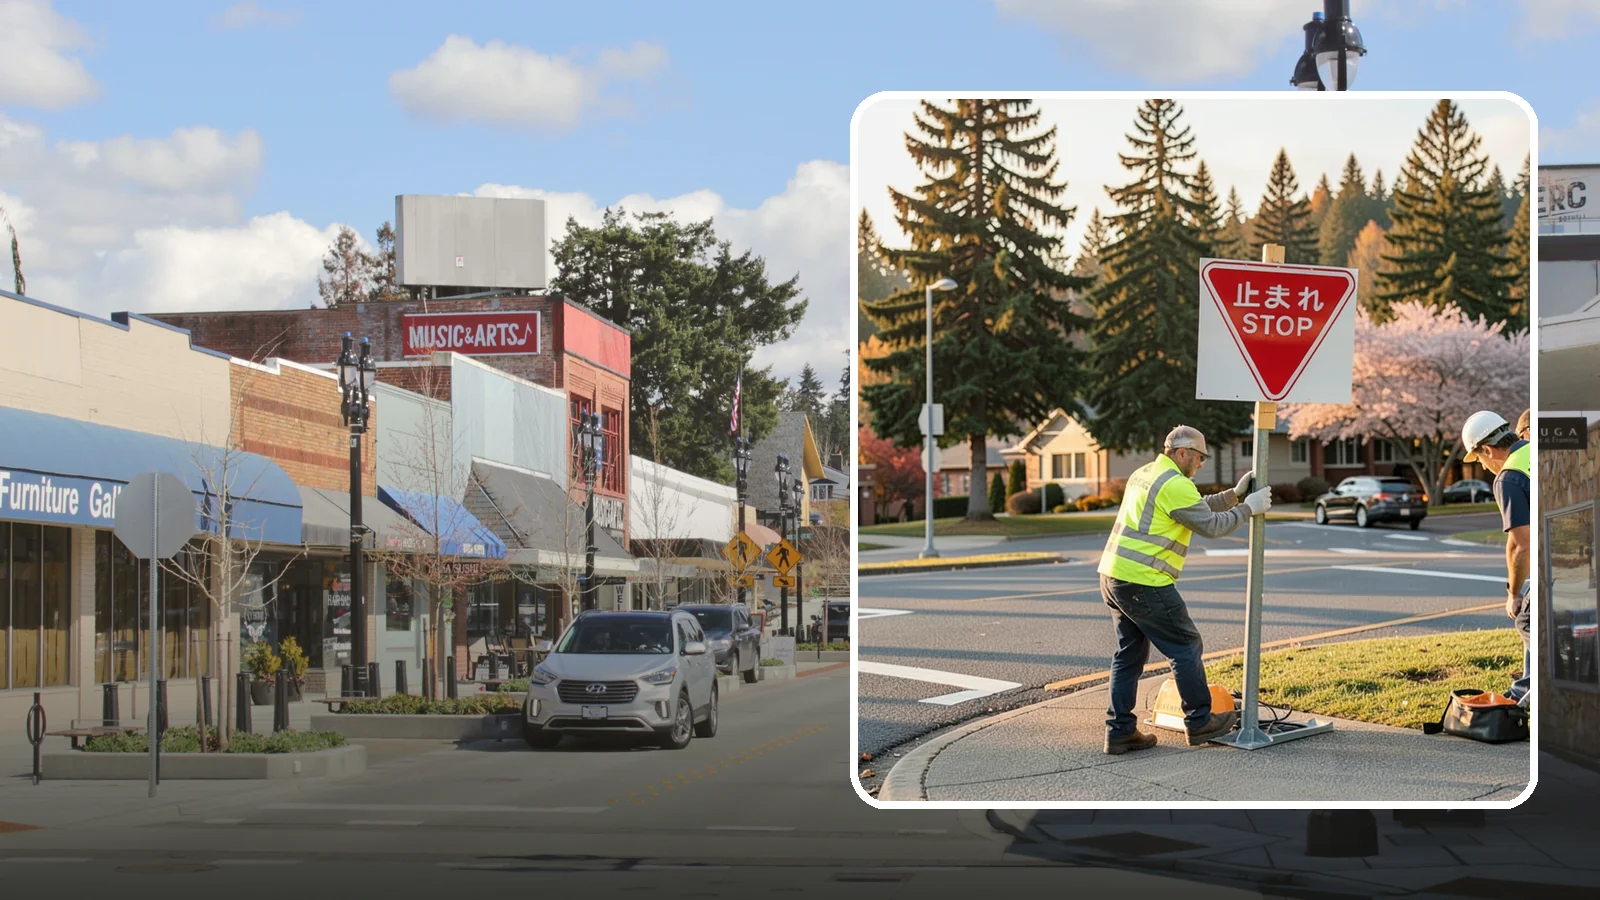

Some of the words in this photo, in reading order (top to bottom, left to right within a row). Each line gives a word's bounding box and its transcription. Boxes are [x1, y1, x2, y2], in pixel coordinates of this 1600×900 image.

[1233, 281, 1324, 312] 止まれ
[1242, 313, 1313, 336] STOP
[1540, 427, 1578, 437] UGA
[0, 471, 79, 515] Furniture
[89, 482, 122, 519] Gal
[453, 562, 480, 575] SUSHI
